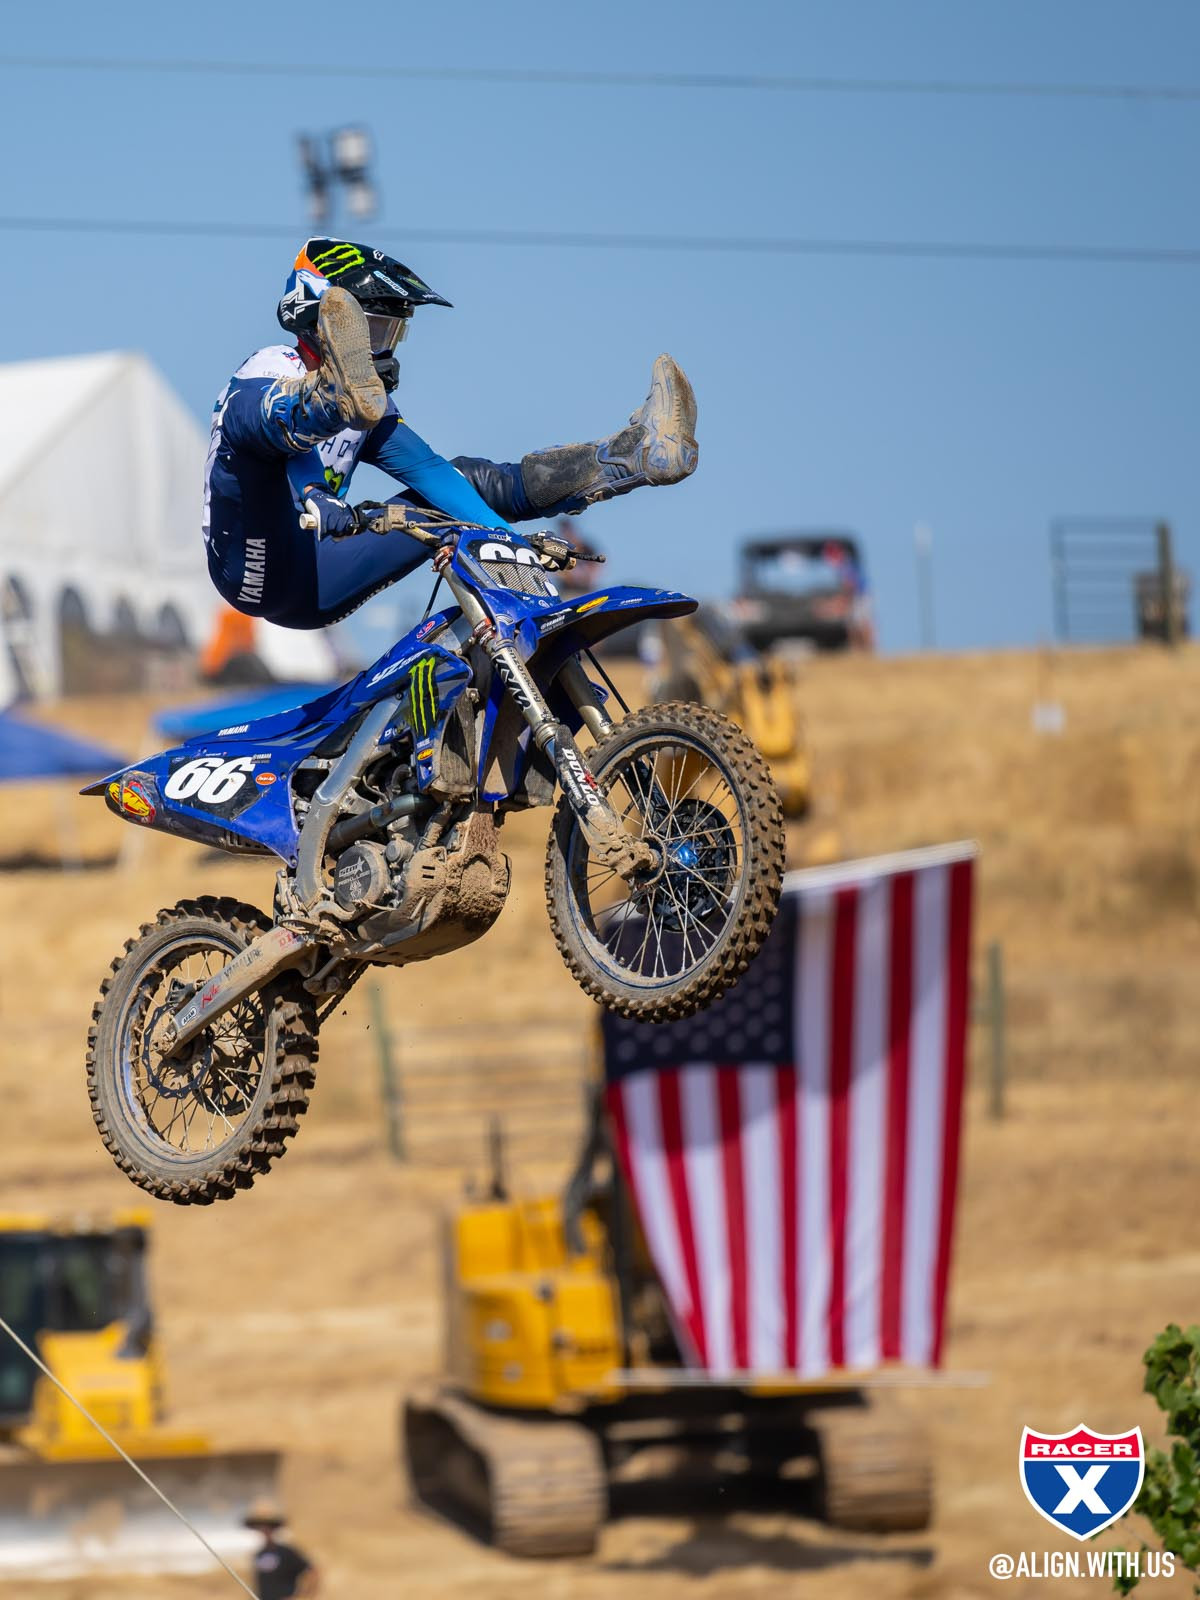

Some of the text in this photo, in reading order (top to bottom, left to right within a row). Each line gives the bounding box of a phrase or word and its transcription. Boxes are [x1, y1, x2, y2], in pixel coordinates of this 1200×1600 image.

[237, 538, 266, 604] YAMAHA
[520, 671, 542, 703] racing
[217, 724, 249, 737] YAMAHA
[164, 757, 256, 804] 66
[562, 748, 603, 808] DUNLO
